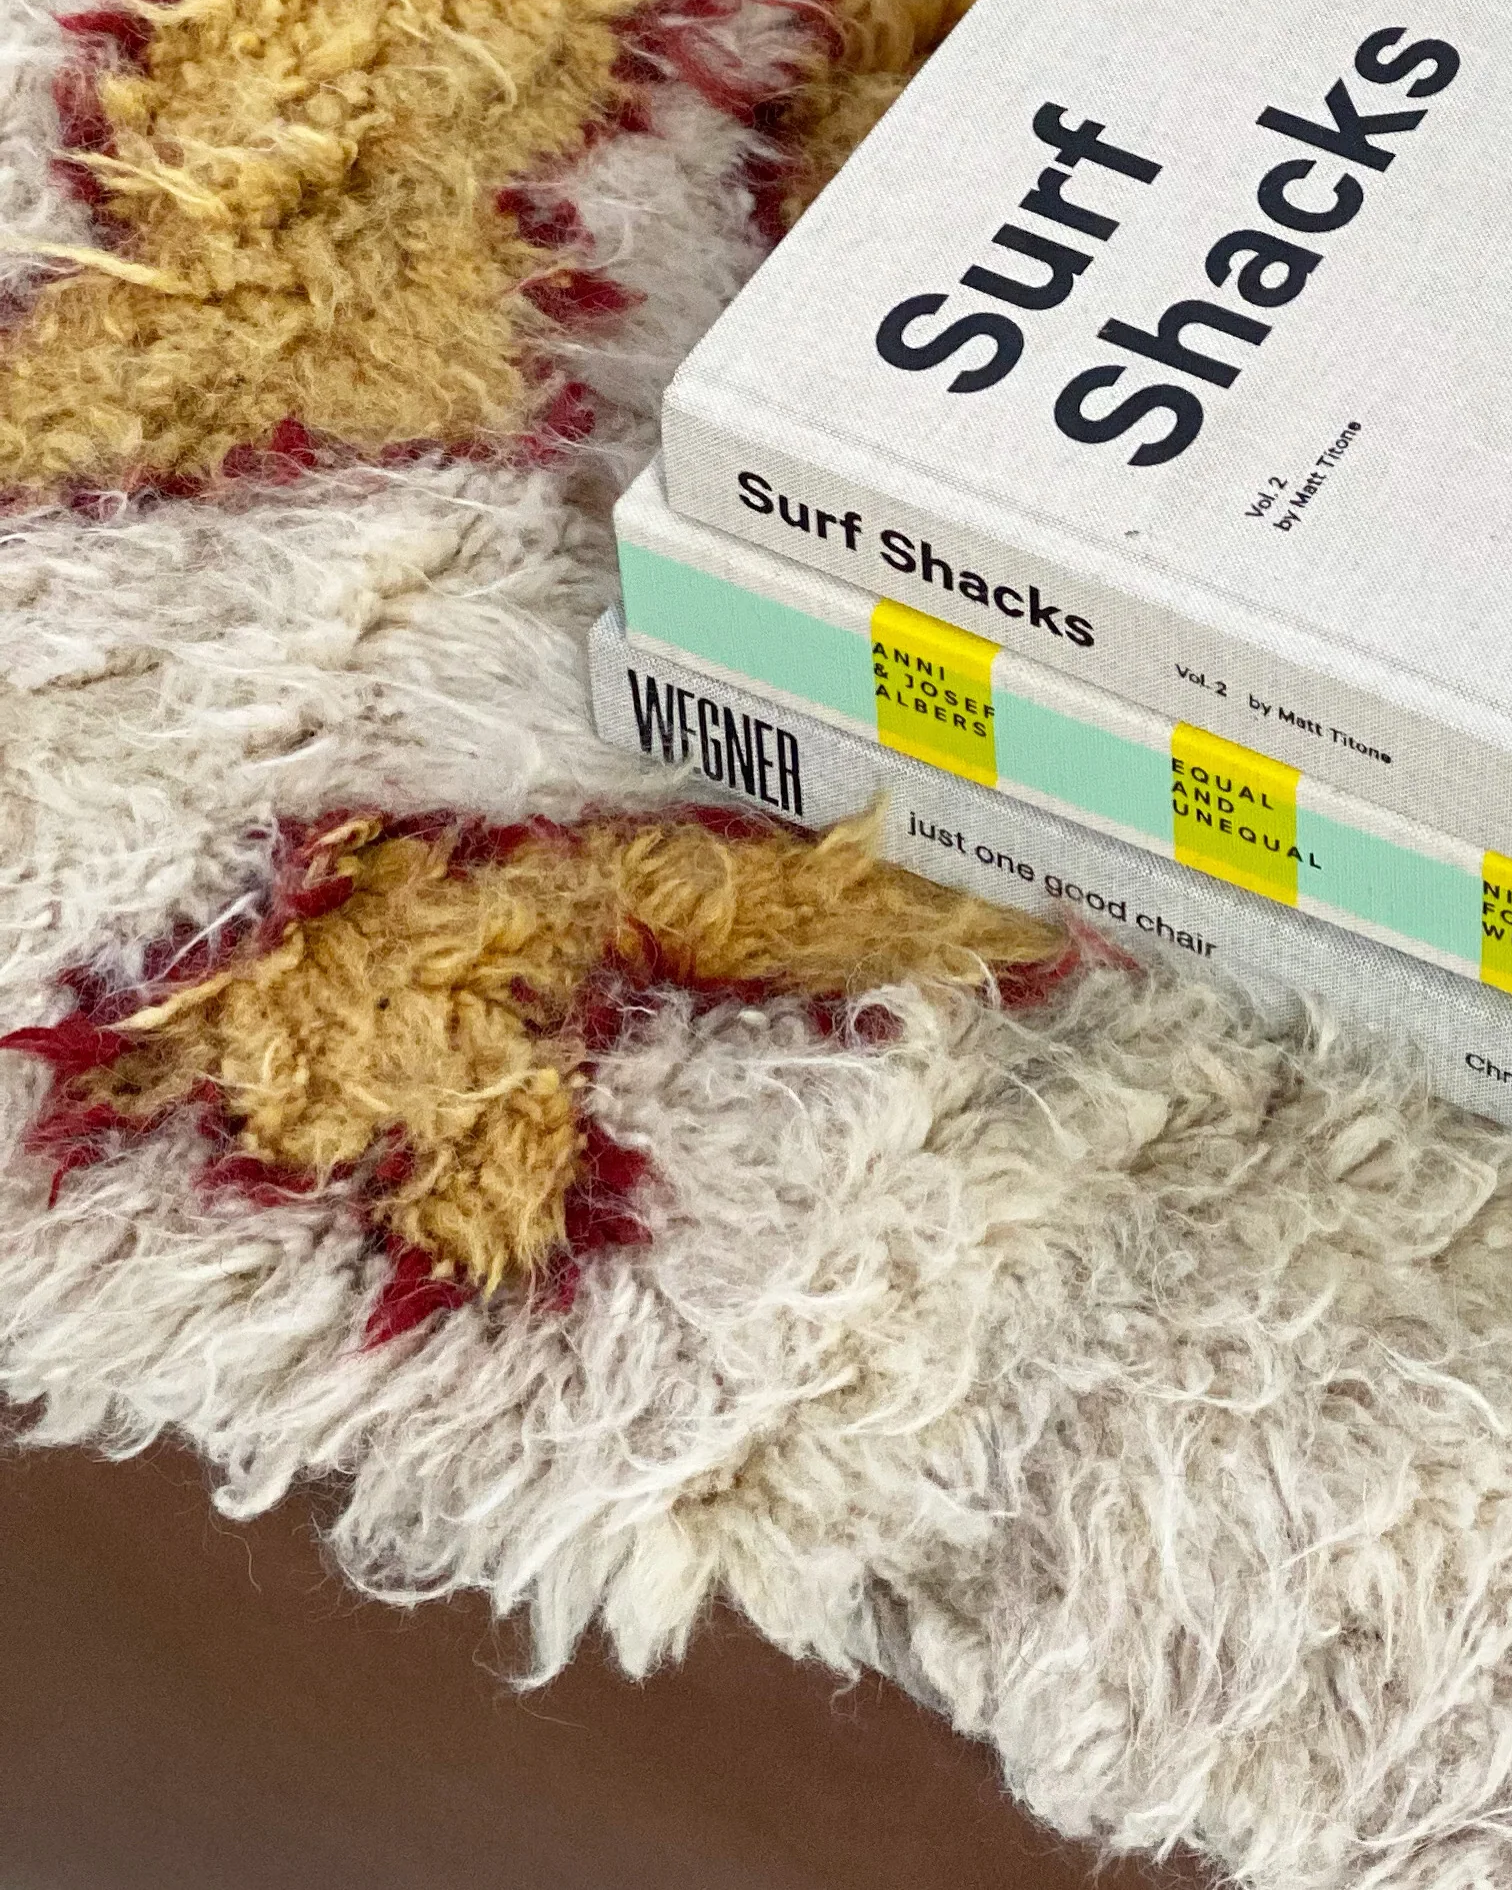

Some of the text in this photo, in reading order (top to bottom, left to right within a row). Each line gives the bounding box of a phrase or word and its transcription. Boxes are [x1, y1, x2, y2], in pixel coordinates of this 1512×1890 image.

[874, 100, 1163, 395] Surf
[1053, 26, 1461, 468] Shacks
[1244, 476, 1288, 517] Vol. 2
[1272, 421, 1362, 532] by Matt Titone
[737, 470, 863, 551] Surf
[879, 528, 1096, 648] Shacks
[1174, 663, 1211, 690] Vol.
[1214, 681, 1228, 697] 2
[1249, 693, 1273, 717] by
[1278, 706, 1324, 738] Matt
[1329, 726, 1392, 765] Titone
[871, 641, 945, 682] ANNI
[873, 662, 996, 720] & JOSEF
[874, 683, 988, 739] ALBERS
[626, 667, 804, 817] WEGNER
[907, 811, 967, 854] just
[974, 844, 1035, 882] one
[1043, 873, 1127, 923] good
[1135, 914, 1217, 959] chair
[1171, 757, 1275, 811] EQUAL
[1171, 780, 1235, 814] AND
[1172, 798, 1323, 871] UNEQUAL
